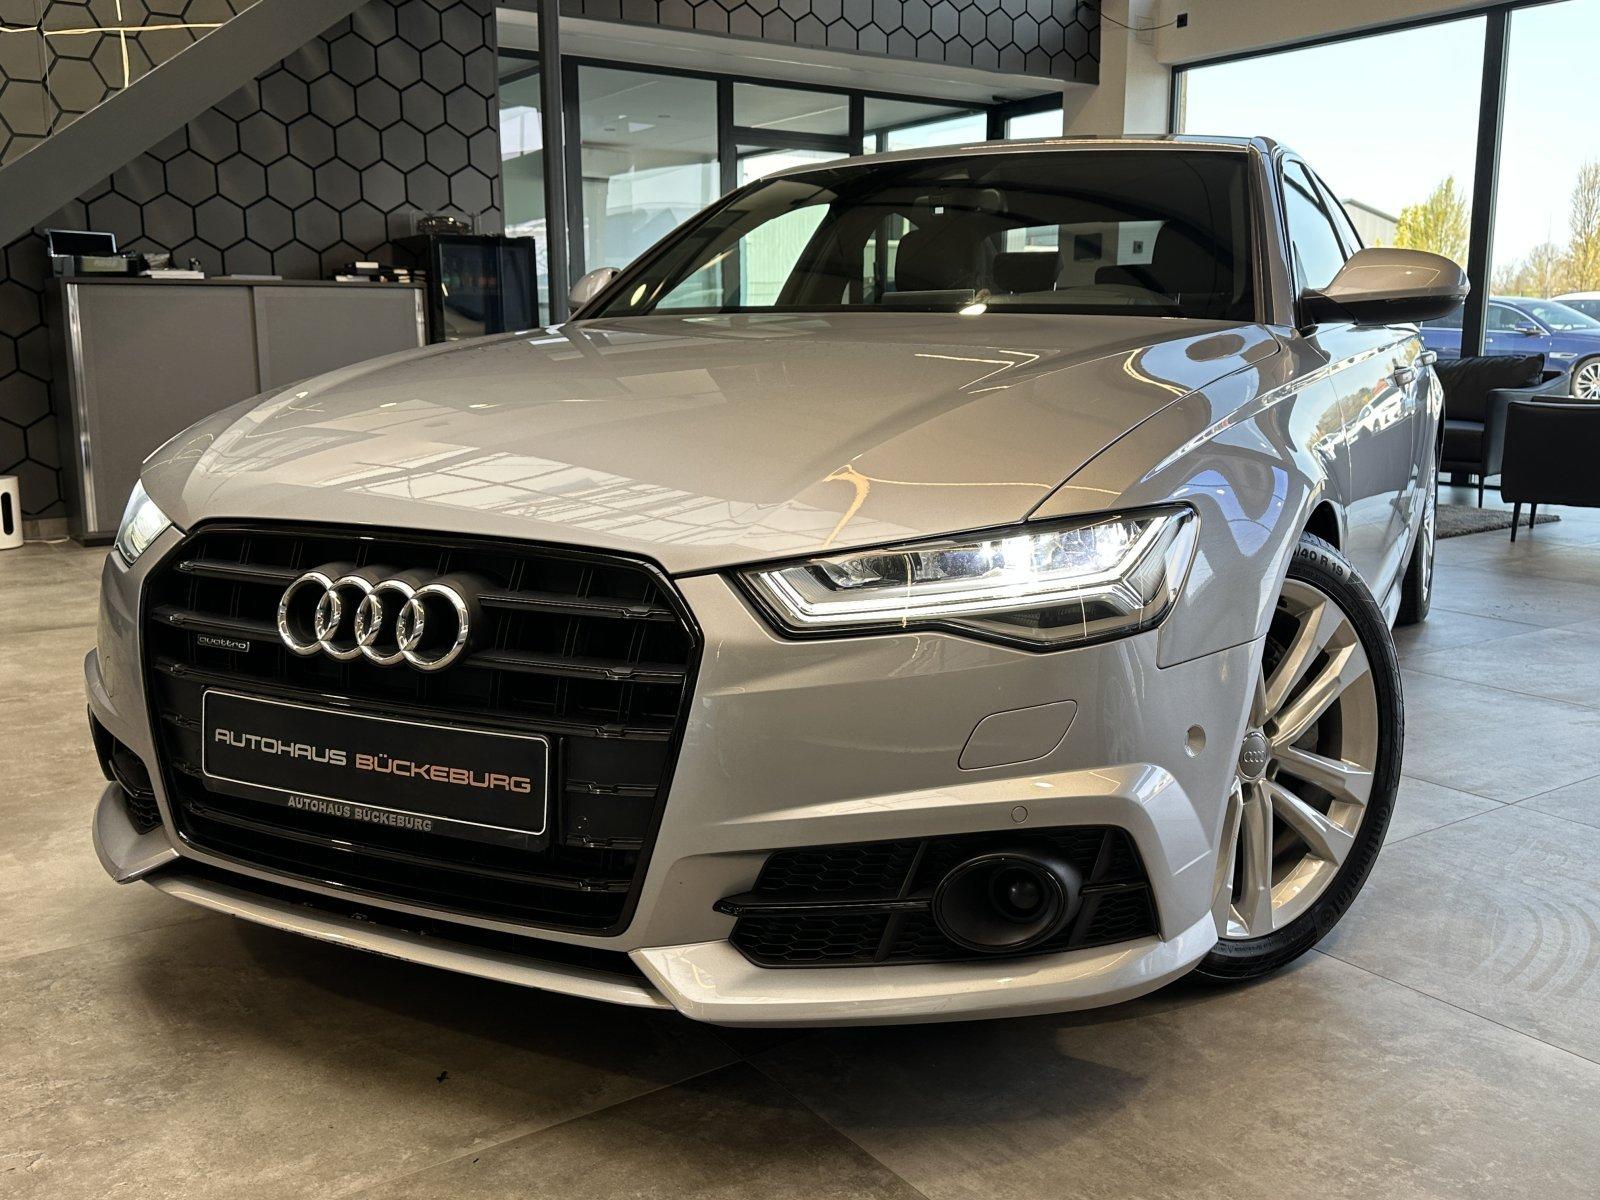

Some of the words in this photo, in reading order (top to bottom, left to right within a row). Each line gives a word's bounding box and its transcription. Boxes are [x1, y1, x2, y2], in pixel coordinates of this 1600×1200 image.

[1320, 554, 1329, 566] R
[1331, 562, 1344, 576] 19
[198, 636, 247, 650] quattro
[215, 728, 347, 766] AUTOHAUS
[355, 753, 531, 793] BÜCKEBURG
[288, 796, 351, 818] AUTOHAUS
[354, 808, 432, 832] BÜCKEBURG
